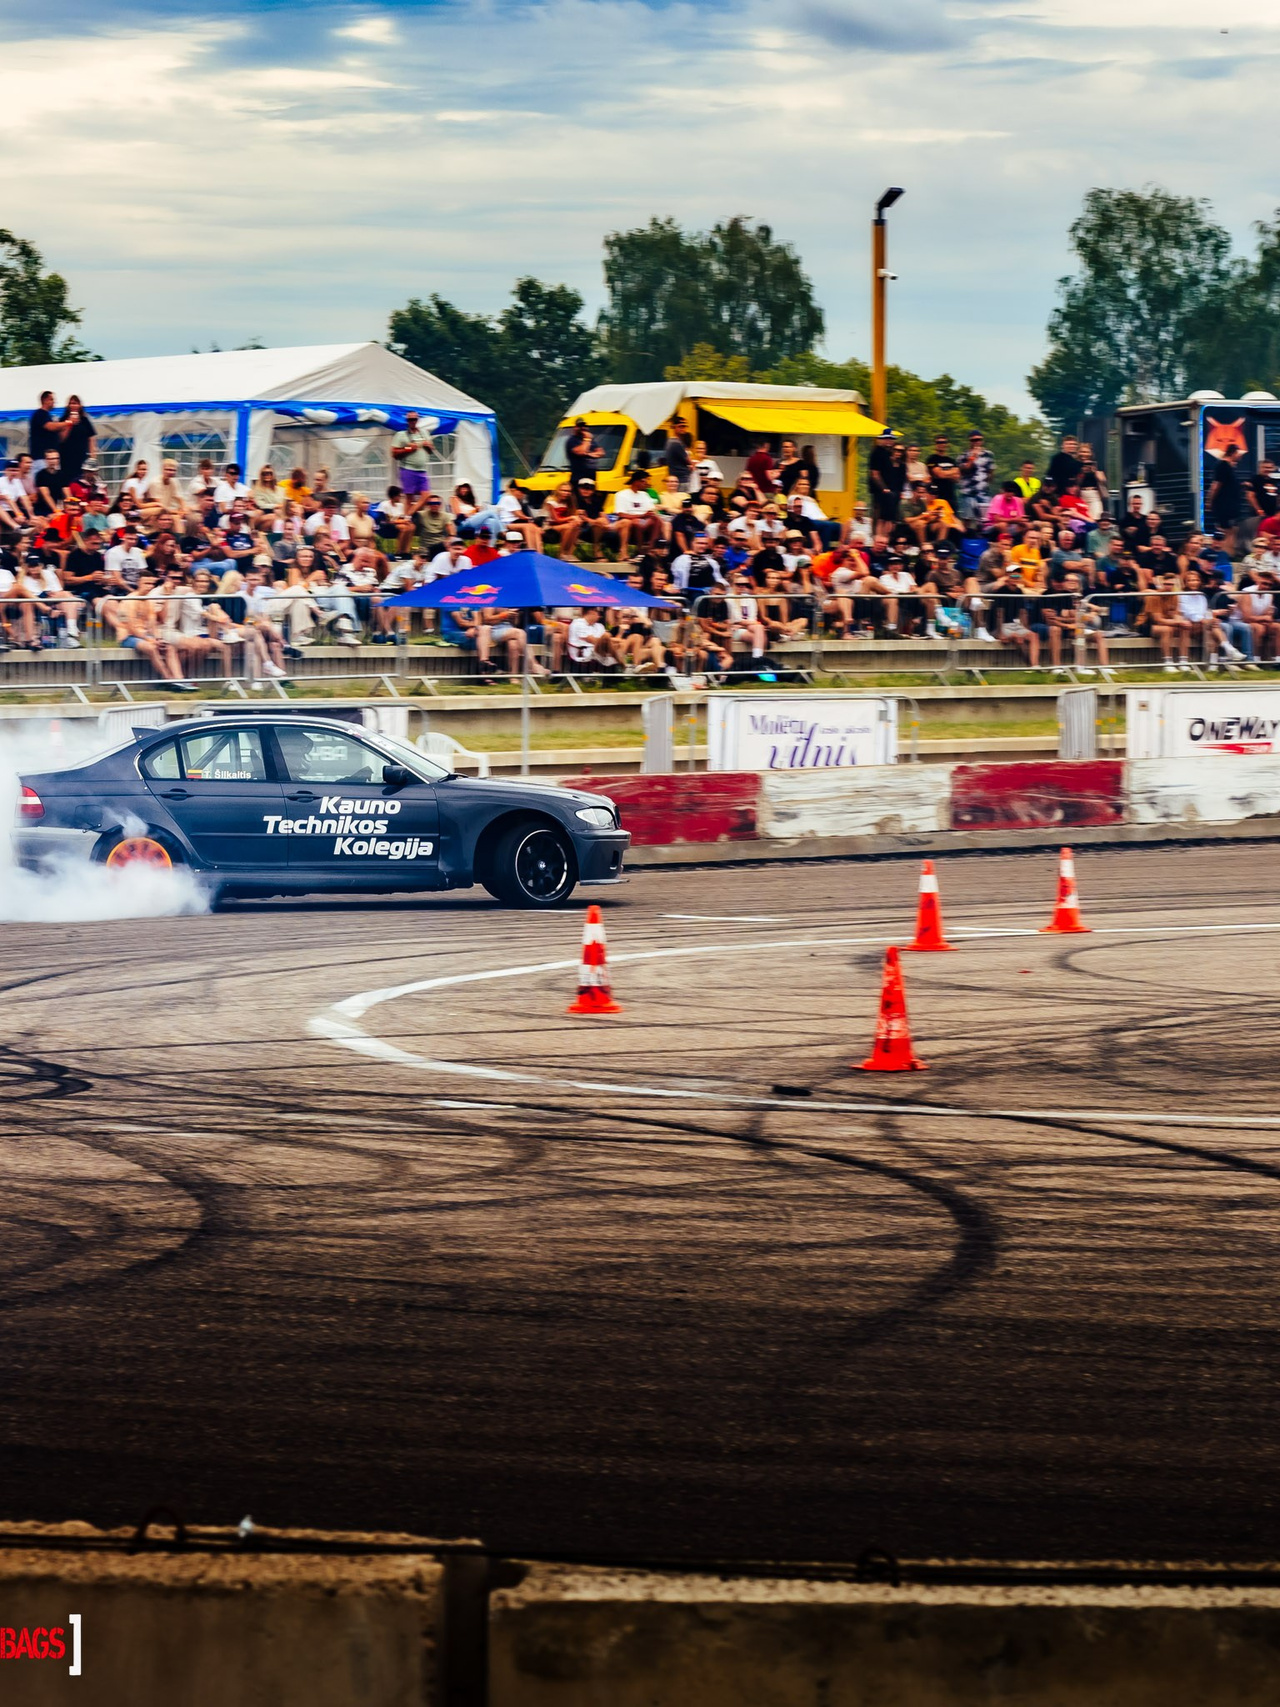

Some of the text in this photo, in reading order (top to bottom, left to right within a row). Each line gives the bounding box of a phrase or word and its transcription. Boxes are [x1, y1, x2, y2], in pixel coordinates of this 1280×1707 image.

[319, 796, 402, 815] Kauno
[263, 815, 389, 834] Technikos
[333, 837, 434, 860] Kolegija
